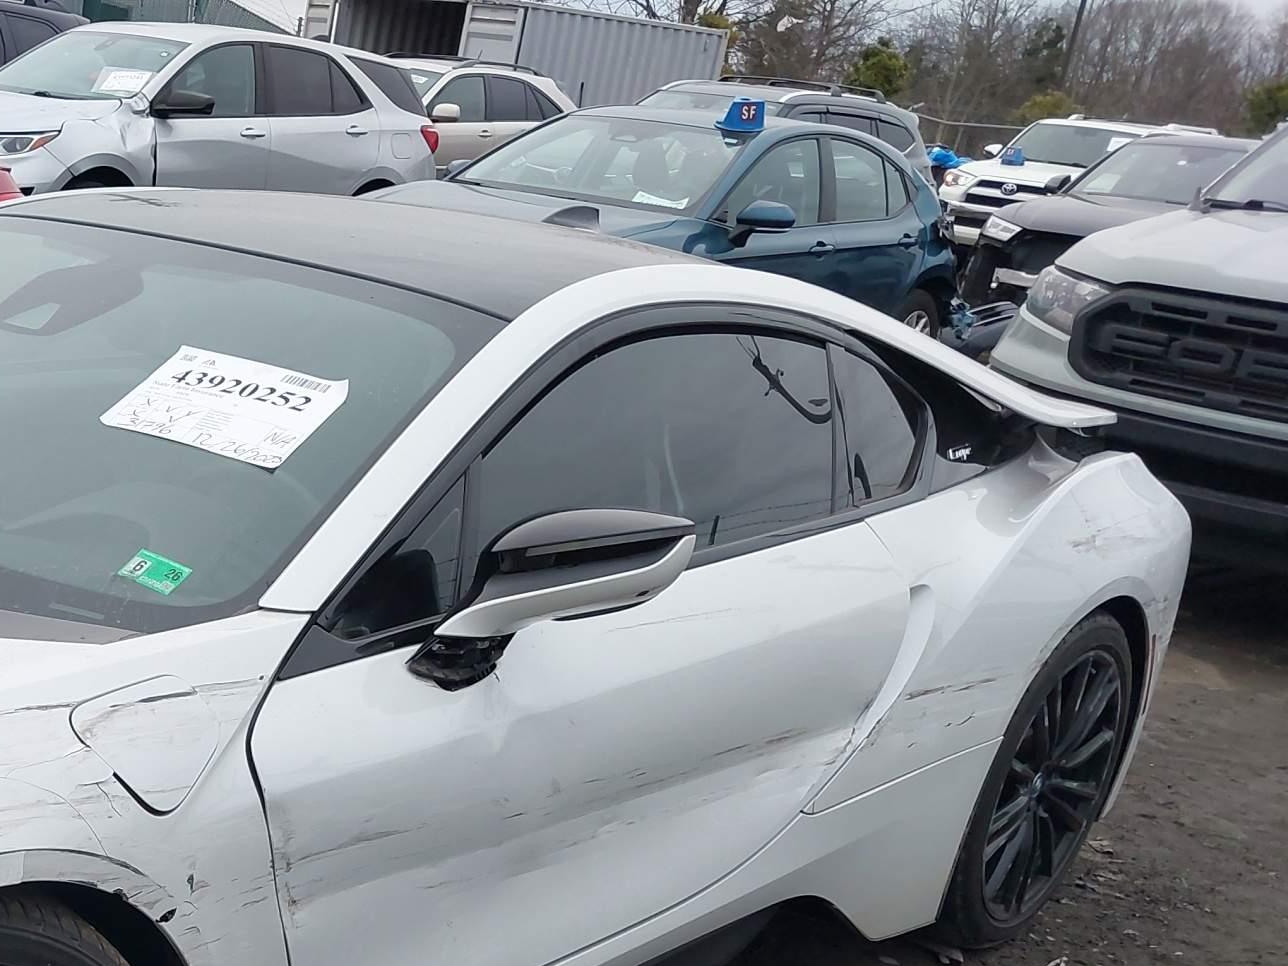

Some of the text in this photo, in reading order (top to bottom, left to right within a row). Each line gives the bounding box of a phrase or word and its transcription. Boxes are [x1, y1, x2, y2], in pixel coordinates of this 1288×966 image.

[741, 105, 757, 120] SF
[170, 369, 312, 412] 43920252
[133, 560, 148, 572] 6
[164, 568, 183, 582] 26
